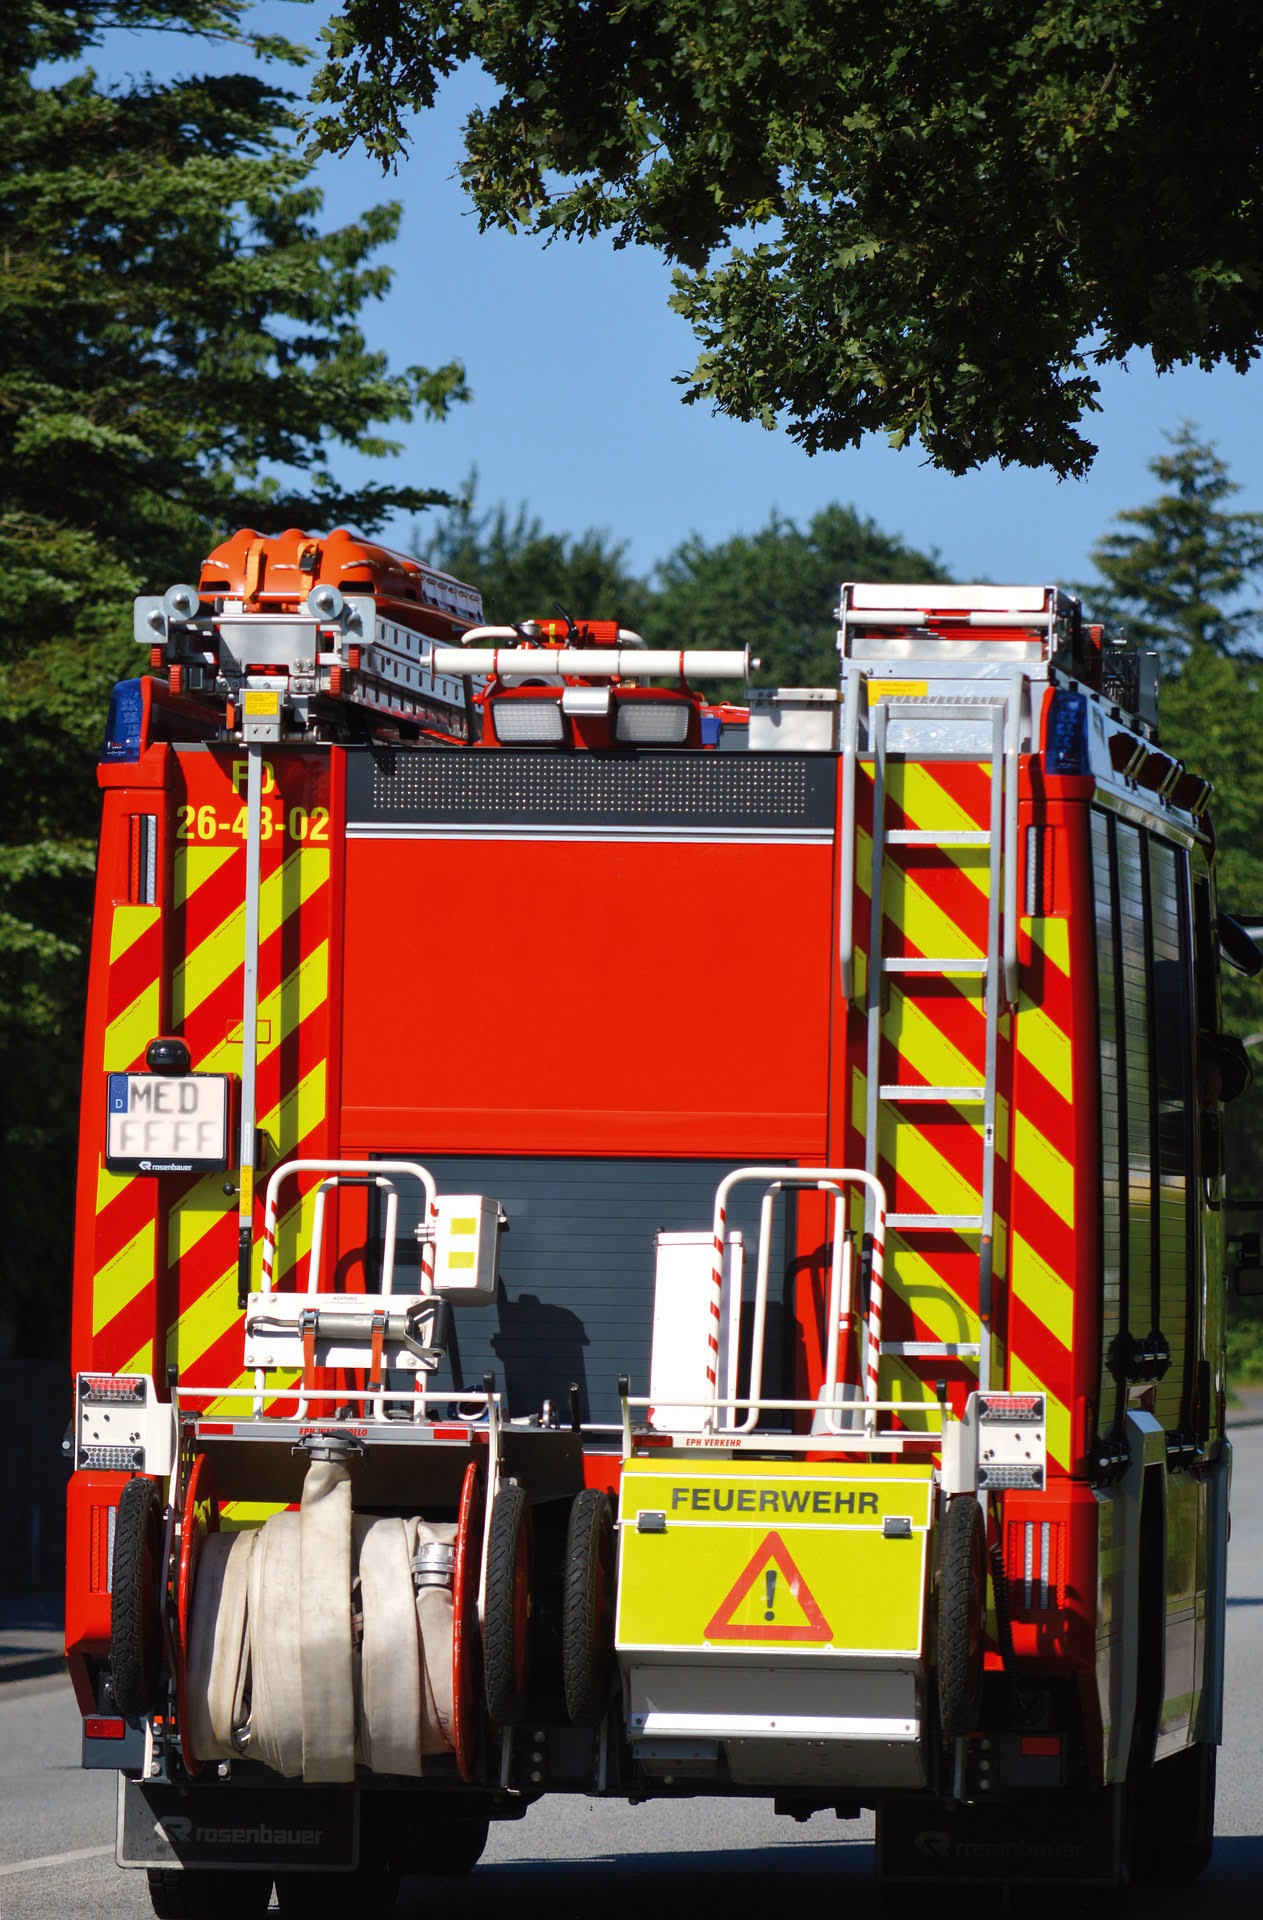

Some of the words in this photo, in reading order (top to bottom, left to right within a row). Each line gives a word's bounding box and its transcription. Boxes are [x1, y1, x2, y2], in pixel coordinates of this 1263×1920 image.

[130, 1081, 199, 1114] MED
[115, 1099, 123, 1109] D
[152, 1163, 193, 1171] rosenbauer
[299, 1427, 315, 1436] EPH
[685, 1438, 702, 1447] EPH
[704, 1438, 742, 1447] VERKEHR
[671, 1487, 879, 1514] FEUERWEHR
[195, 1824, 322, 1845] rosenbauer
